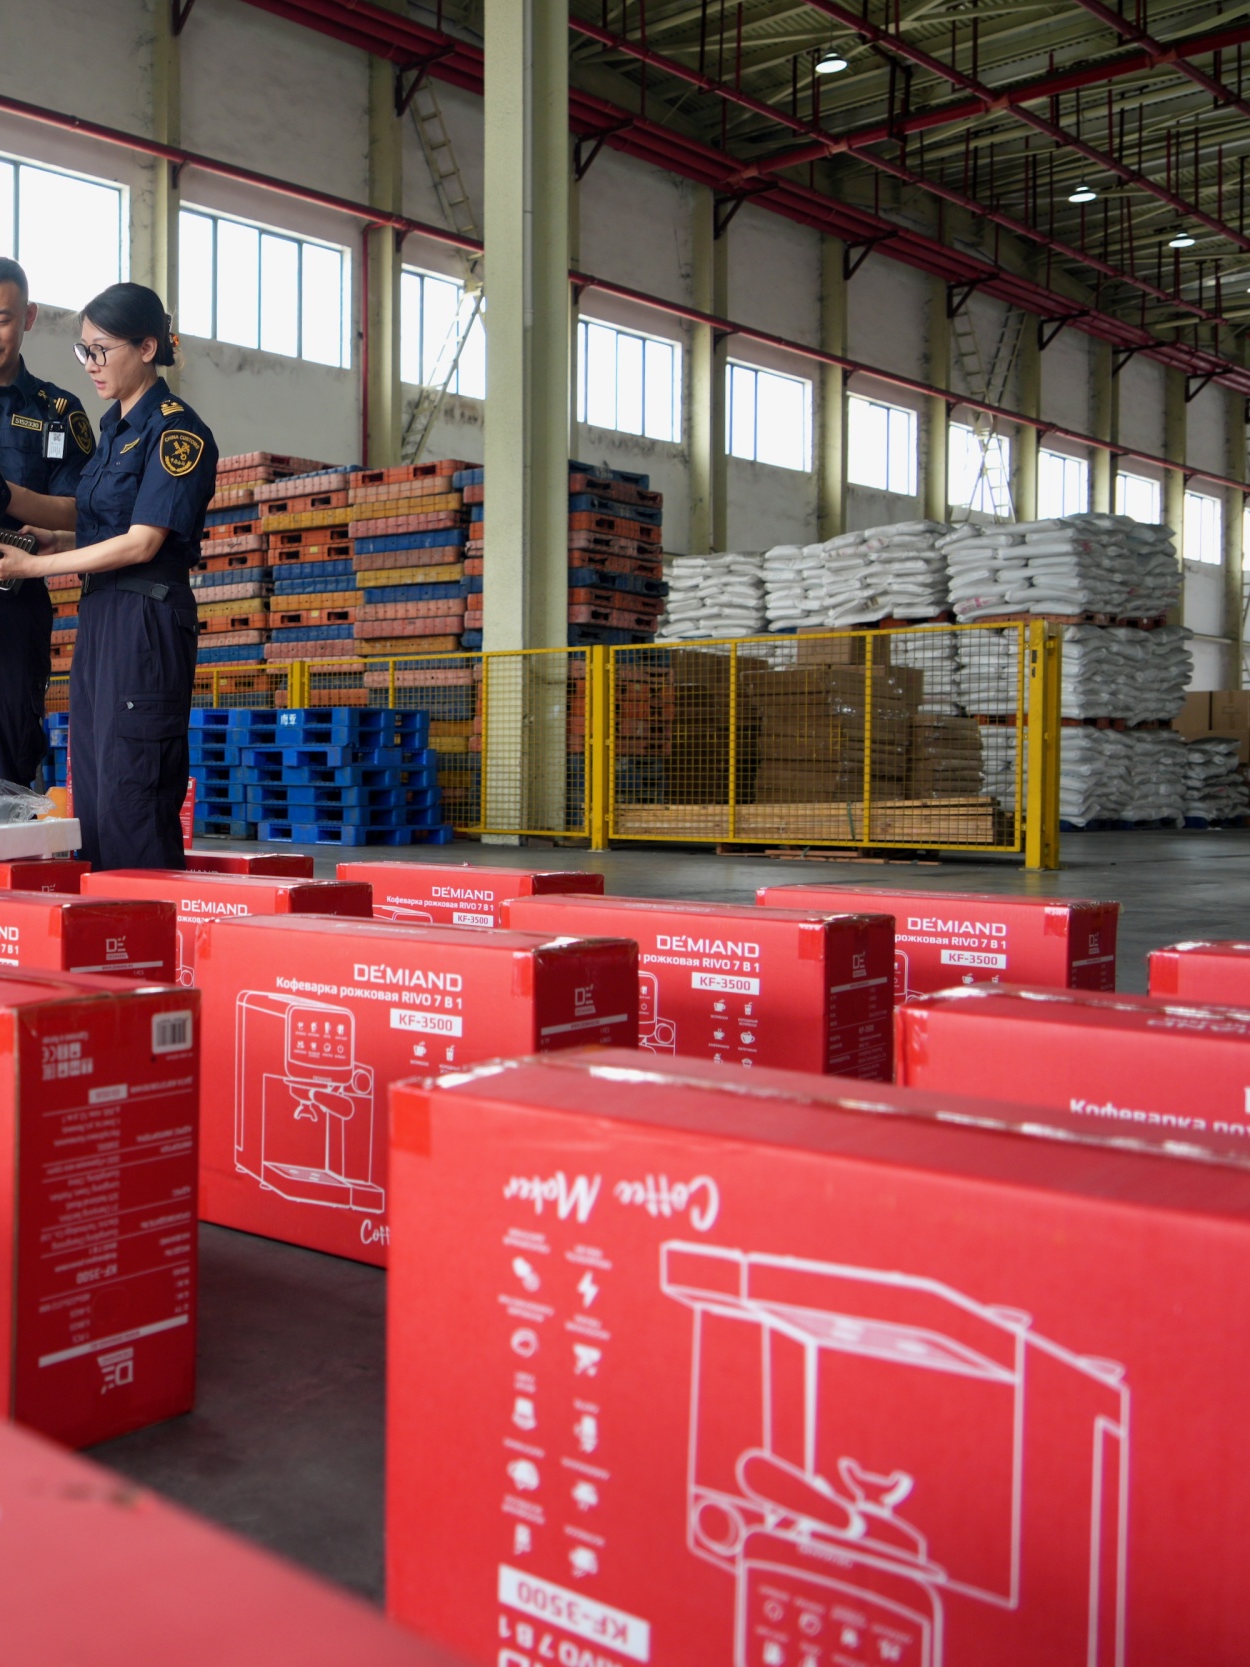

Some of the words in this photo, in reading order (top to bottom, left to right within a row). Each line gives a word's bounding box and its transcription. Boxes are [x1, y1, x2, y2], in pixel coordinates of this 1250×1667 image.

[387, 896, 423, 906] Кофеварка
[424, 900, 458, 909] рожковая
[460, 902, 476, 910] RIVO
[458, 915, 489, 925] KF-3500
[1, 943, 6, 953] 7
[15, 945, 19, 954] 1
[895, 934, 949, 945] рожковая
[952, 936, 978, 948] RIVO
[981, 939, 988, 948] 7
[1001, 940, 1006, 949] 1
[643, 954, 700, 966] рожковая
[702, 958, 730, 970] RIVO
[733, 961, 740, 970] 7
[754, 963, 759, 972] 1
[949, 954, 998, 966] KF-3500
[700, 976, 751, 991] KF-3500
[276, 976, 337, 997] Кофеварка
[340, 986, 399, 1002] рожковая
[402, 992, 431, 1006] RIVO
[434, 994, 442, 1007] 7
[456, 997, 462, 1010] 1
[399, 1013, 453, 1032] KF-3500
[503, 1170, 602, 1223] Maker
[613, 1174, 719, 1232] Coffee
[360, 1219, 390, 1246] Coff
[517, 1581, 628, 1646] KF-3500
